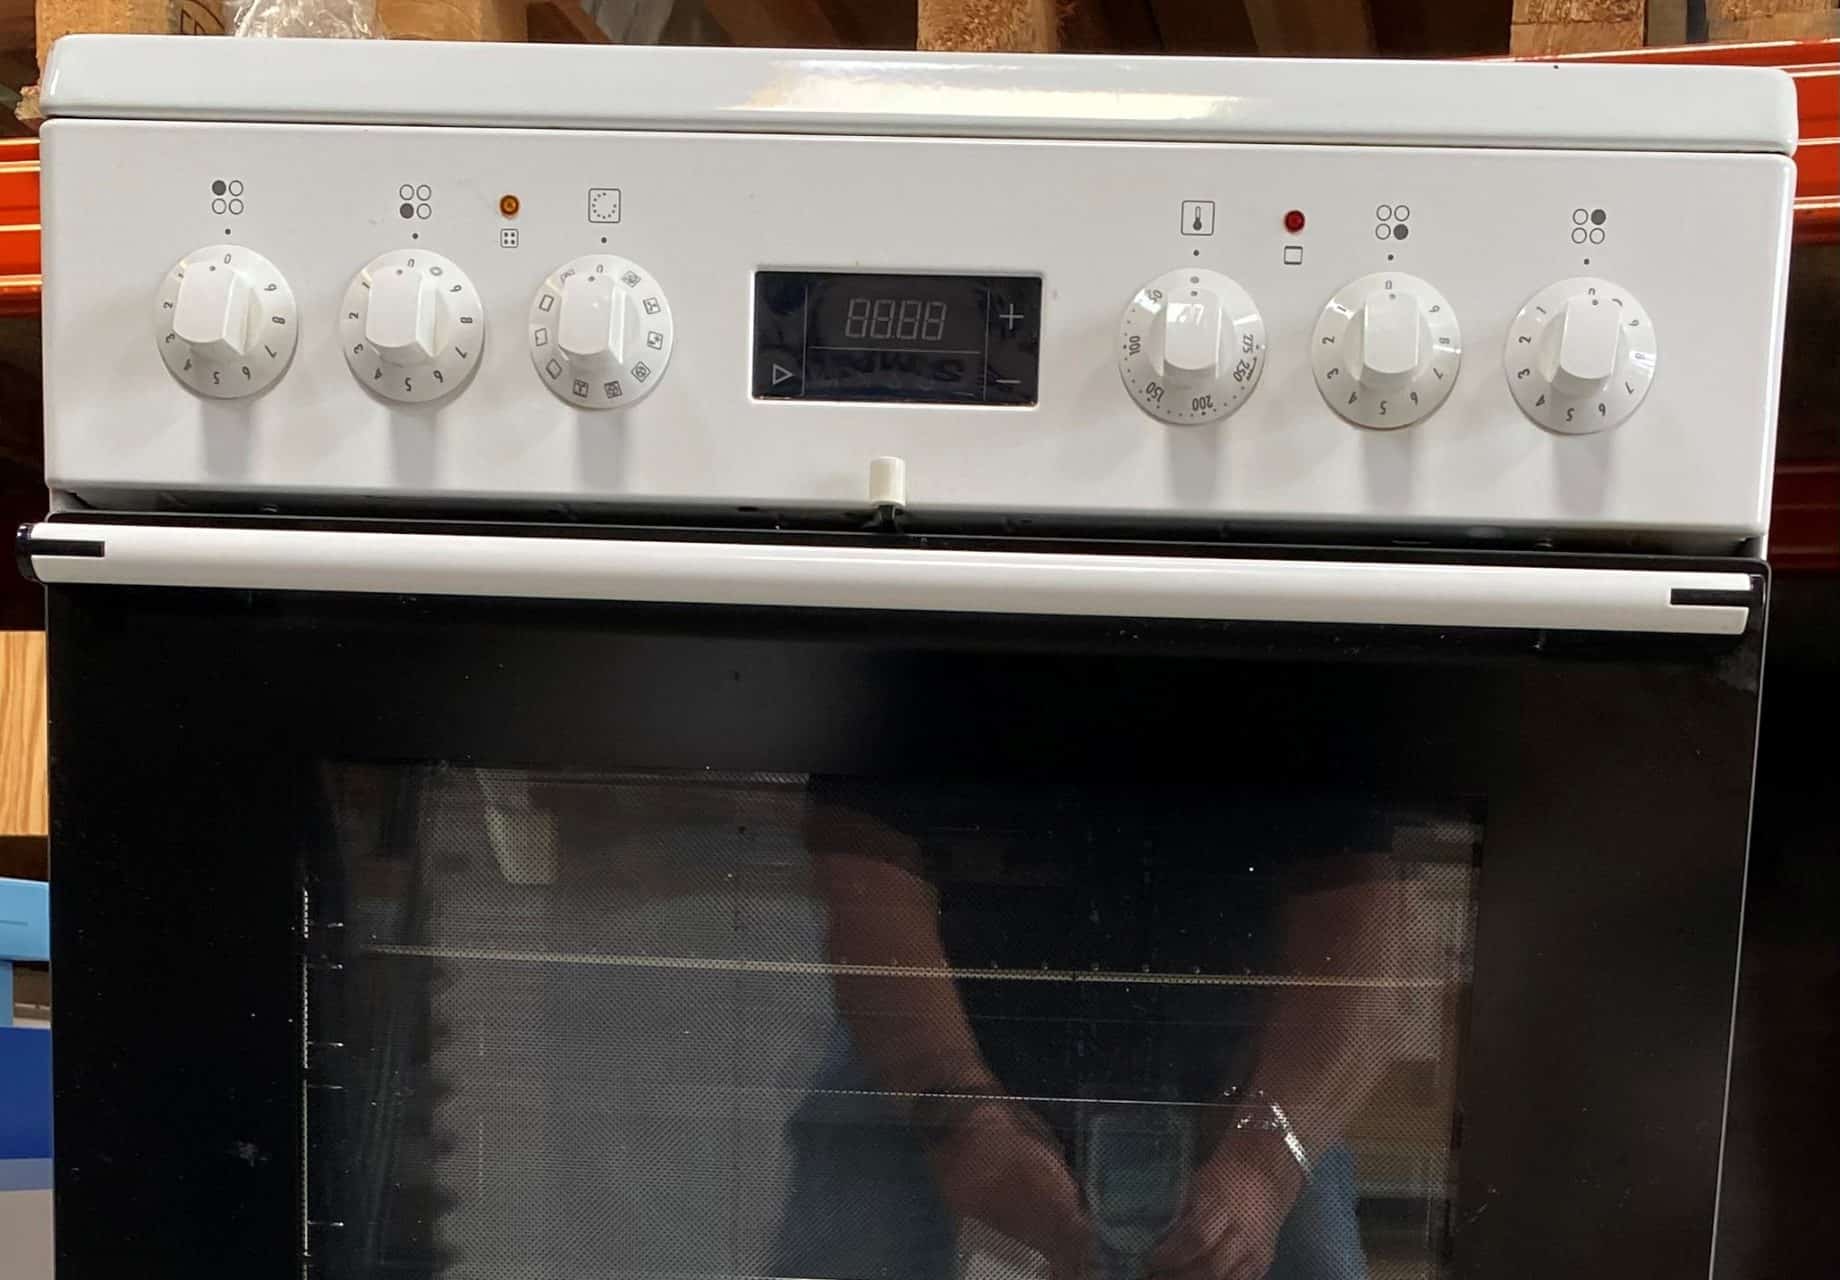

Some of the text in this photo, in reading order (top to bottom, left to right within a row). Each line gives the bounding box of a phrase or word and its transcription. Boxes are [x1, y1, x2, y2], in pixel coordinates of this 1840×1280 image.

[1129, 336, 1140, 356] 100
[1146, 382, 1165, 402] 150
[1192, 395, 1213, 411] 200
[1233, 360, 1250, 382] 250
